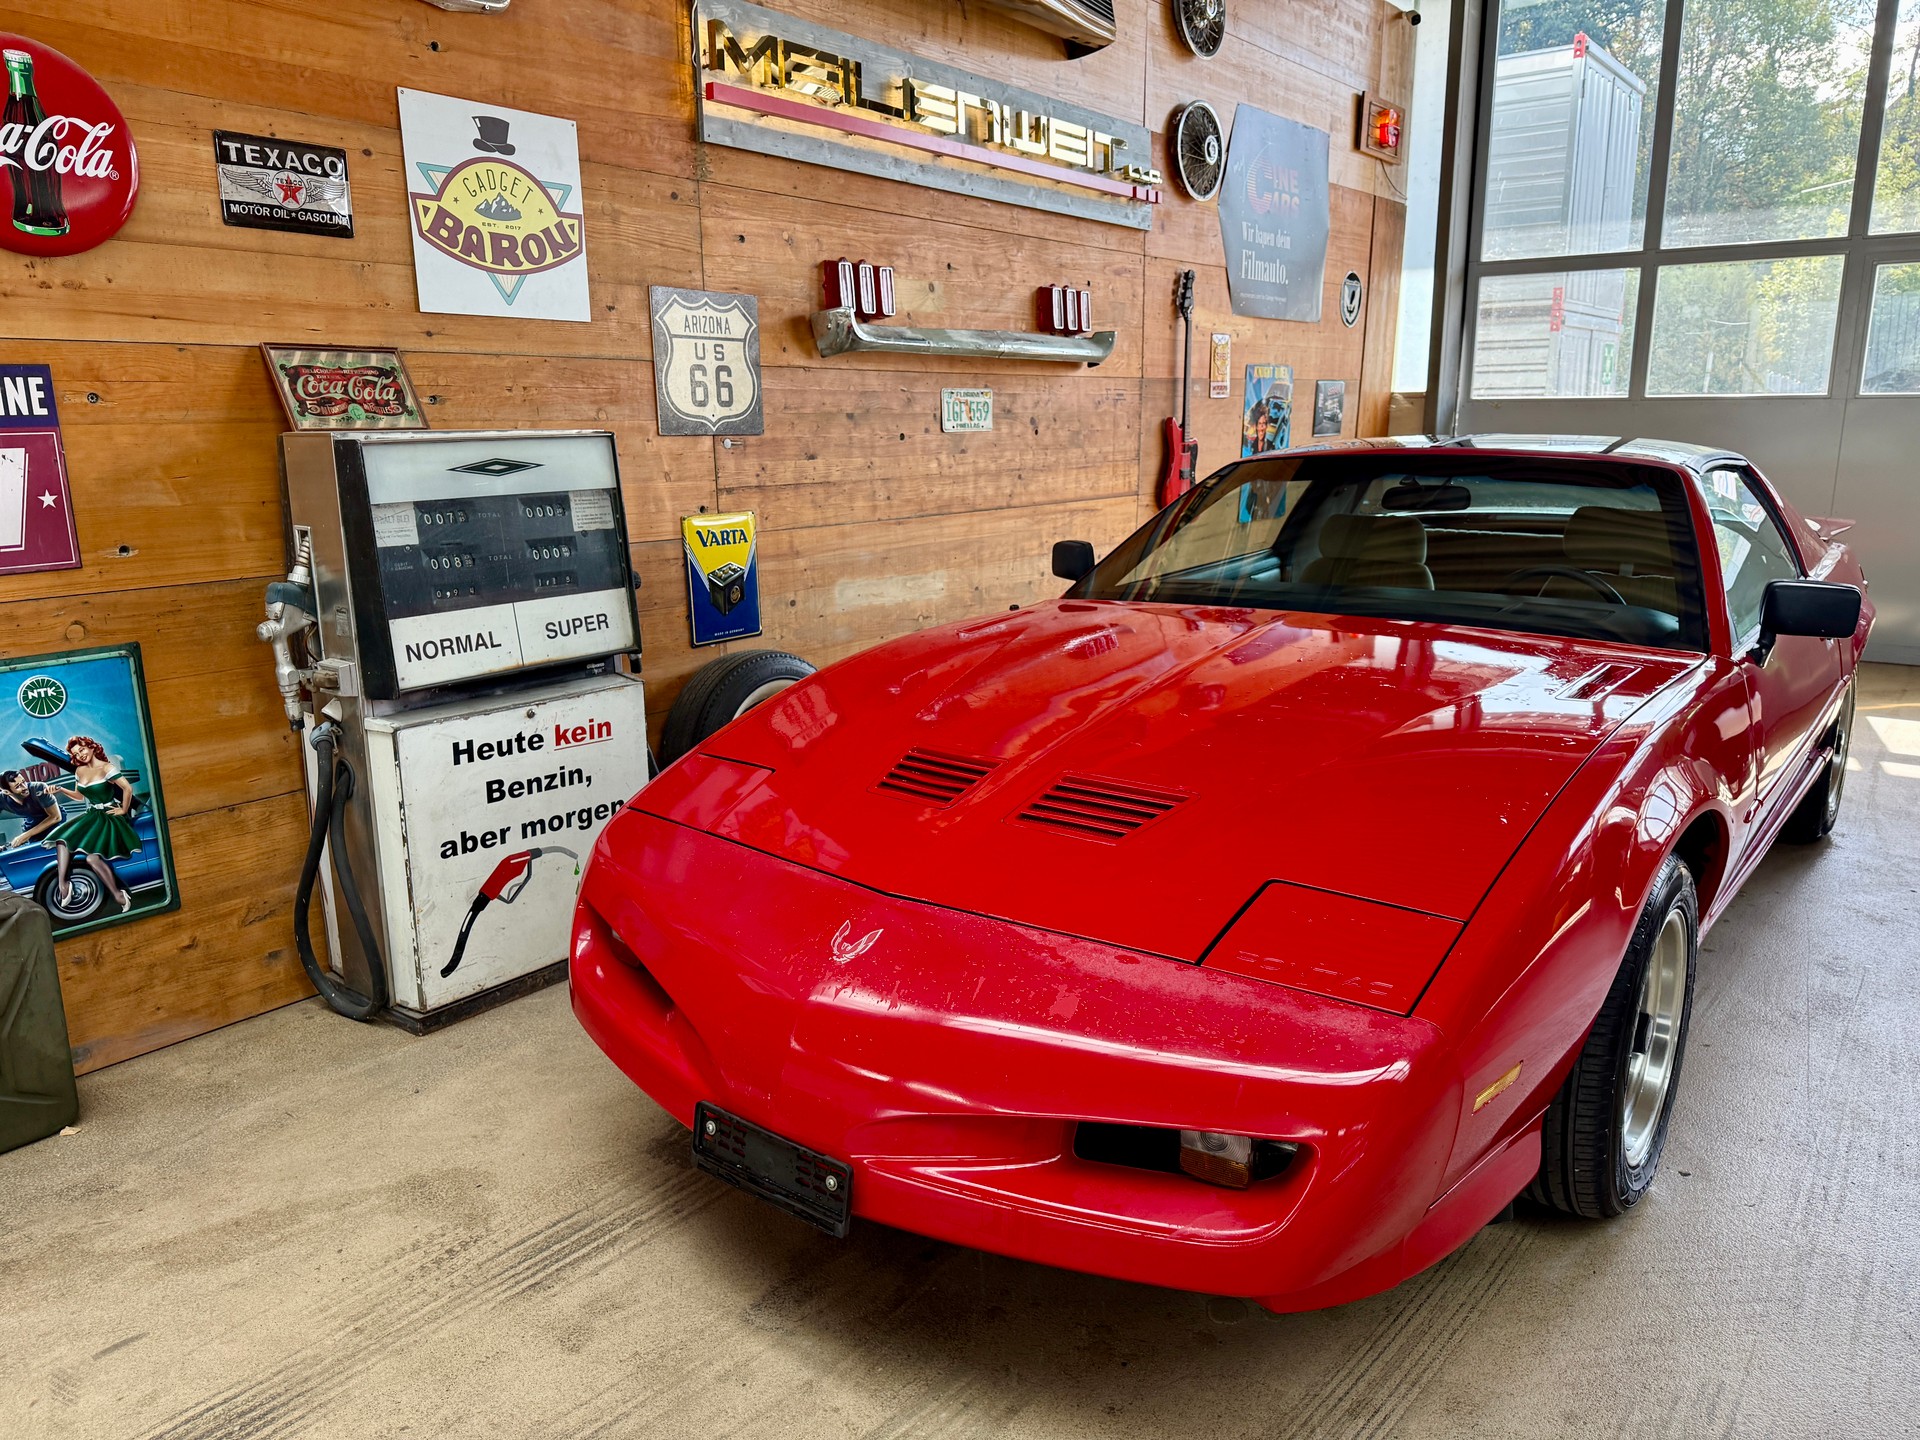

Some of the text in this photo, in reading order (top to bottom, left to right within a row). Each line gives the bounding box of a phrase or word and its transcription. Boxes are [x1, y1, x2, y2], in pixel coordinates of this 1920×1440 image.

[221, 141, 344, 177] TEXACO
[462, 169, 534, 204] GADGET
[229, 203, 271, 217] MOTOR
[272, 208, 291, 219] OIL
[425, 204, 578, 268] BARON
[1241, 220, 1254, 243] Wir
[1275, 228, 1292, 250] dein
[1240, 249, 1289, 286] Filmauto.
[683, 314, 732, 335] ARIZONA
[0, 376, 49, 417] NE
[296, 374, 397, 400] Coca-Cola
[689, 363, 734, 408] 66
[695, 528, 749, 548] VARTA
[405, 612, 610, 663] NORMAL SUPER
[28, 687, 57, 700] NTK
[452, 718, 613, 766] Heute kein
[486, 766, 593, 804] Benzin,
[439, 799, 626, 860] aber morgen
